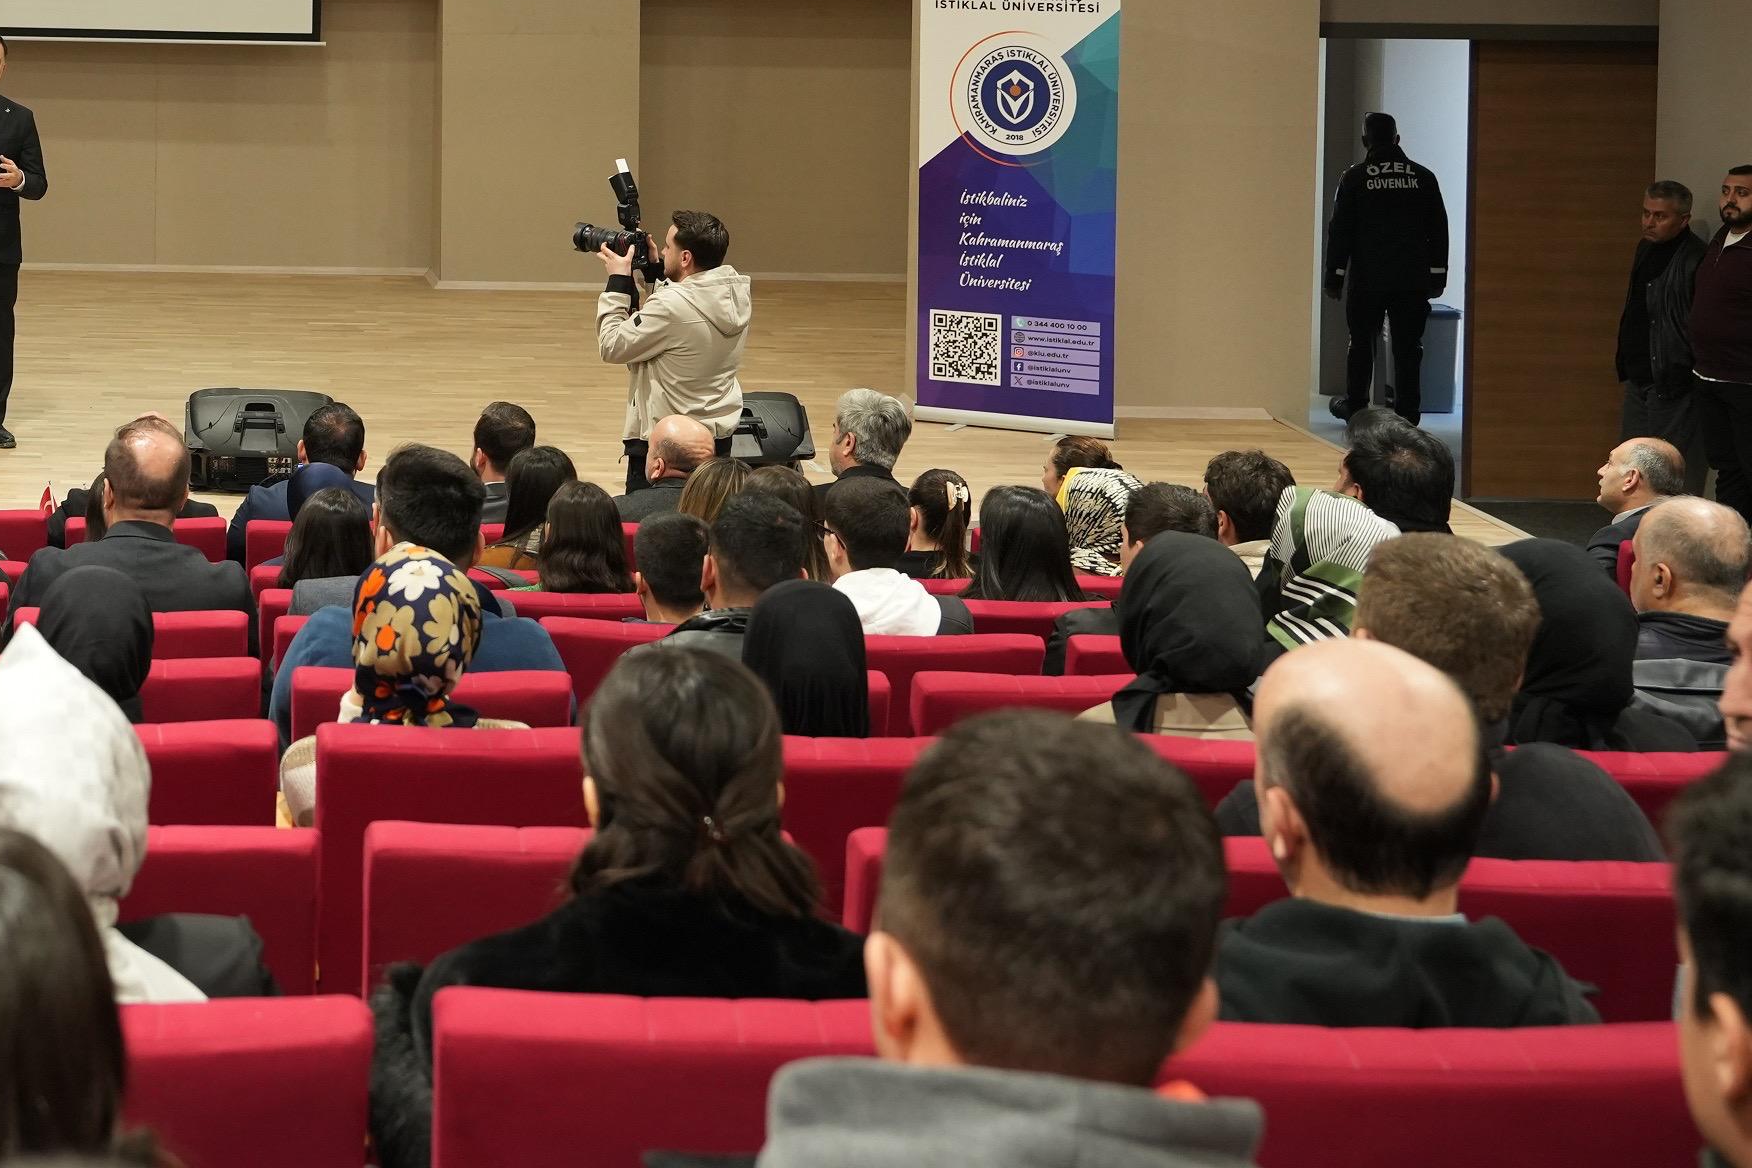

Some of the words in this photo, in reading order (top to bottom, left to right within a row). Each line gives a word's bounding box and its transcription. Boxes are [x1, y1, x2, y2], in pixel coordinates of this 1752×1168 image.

[1002, 0, 1100, 13] ÜNİVERSİTESİ
[970, 52, 1004, 135] KAHRAMANMARAŞ
[1006, 49, 1049, 73] İSTİKLAL
[1032, 72, 1061, 138] ÜNİVERSİTESİ
[1366, 162, 1416, 176] ÖZEL
[1366, 176, 1419, 190] GÜVENLİK
[960, 189, 1028, 208] İstikbaliniz
[959, 212, 982, 228] için
[959, 232, 1064, 256] Kahramanmaraş
[959, 251, 1004, 268] İstiklal
[959, 271, 1032, 292] Üniversitesi
[1028, 336, 1095, 346] www.istiklal.edu.tr
[1027, 350, 1069, 359] @kiu.edu.tr
[1027, 365, 1072, 374] @istiklalunv
[1027, 379, 1070, 388] @istiklalunv
